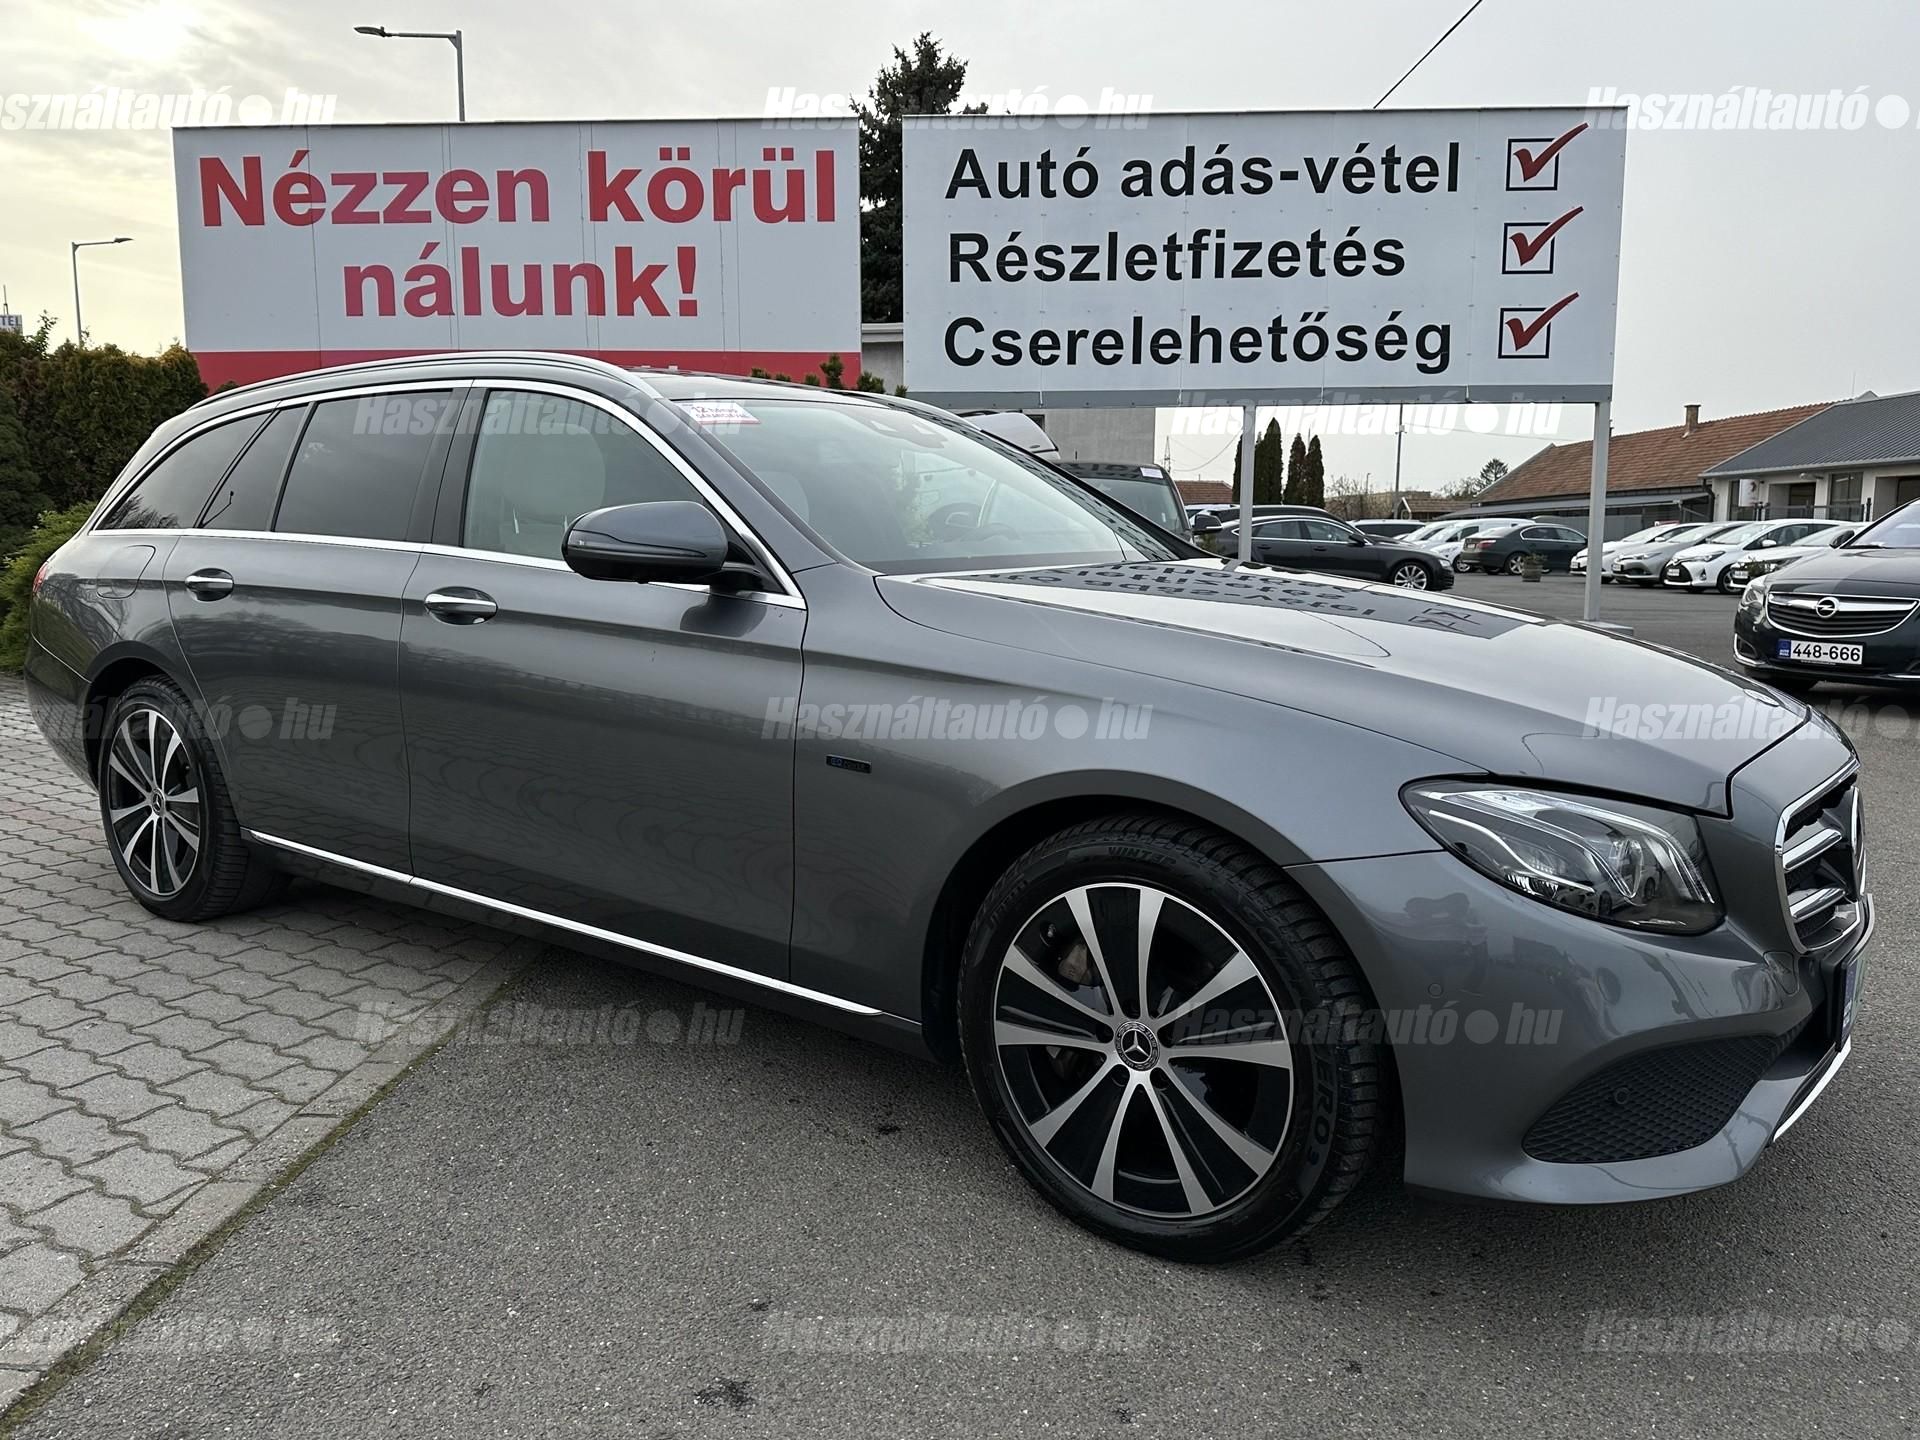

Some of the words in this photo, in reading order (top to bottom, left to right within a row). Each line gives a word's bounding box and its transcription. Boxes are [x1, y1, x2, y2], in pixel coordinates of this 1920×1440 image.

[199, 150, 548, 227] Nézzen
[589, 147, 835, 223] körül
[944, 146, 1099, 199] Autó
[1120, 142, 1460, 198] adás-vétel
[344, 242, 698, 318] nálunk!
[949, 226, 1405, 283] Részletfizetés
[944, 310, 1451, 375] Cserelehetőség
[1793, 643, 1861, 662] 448-666
